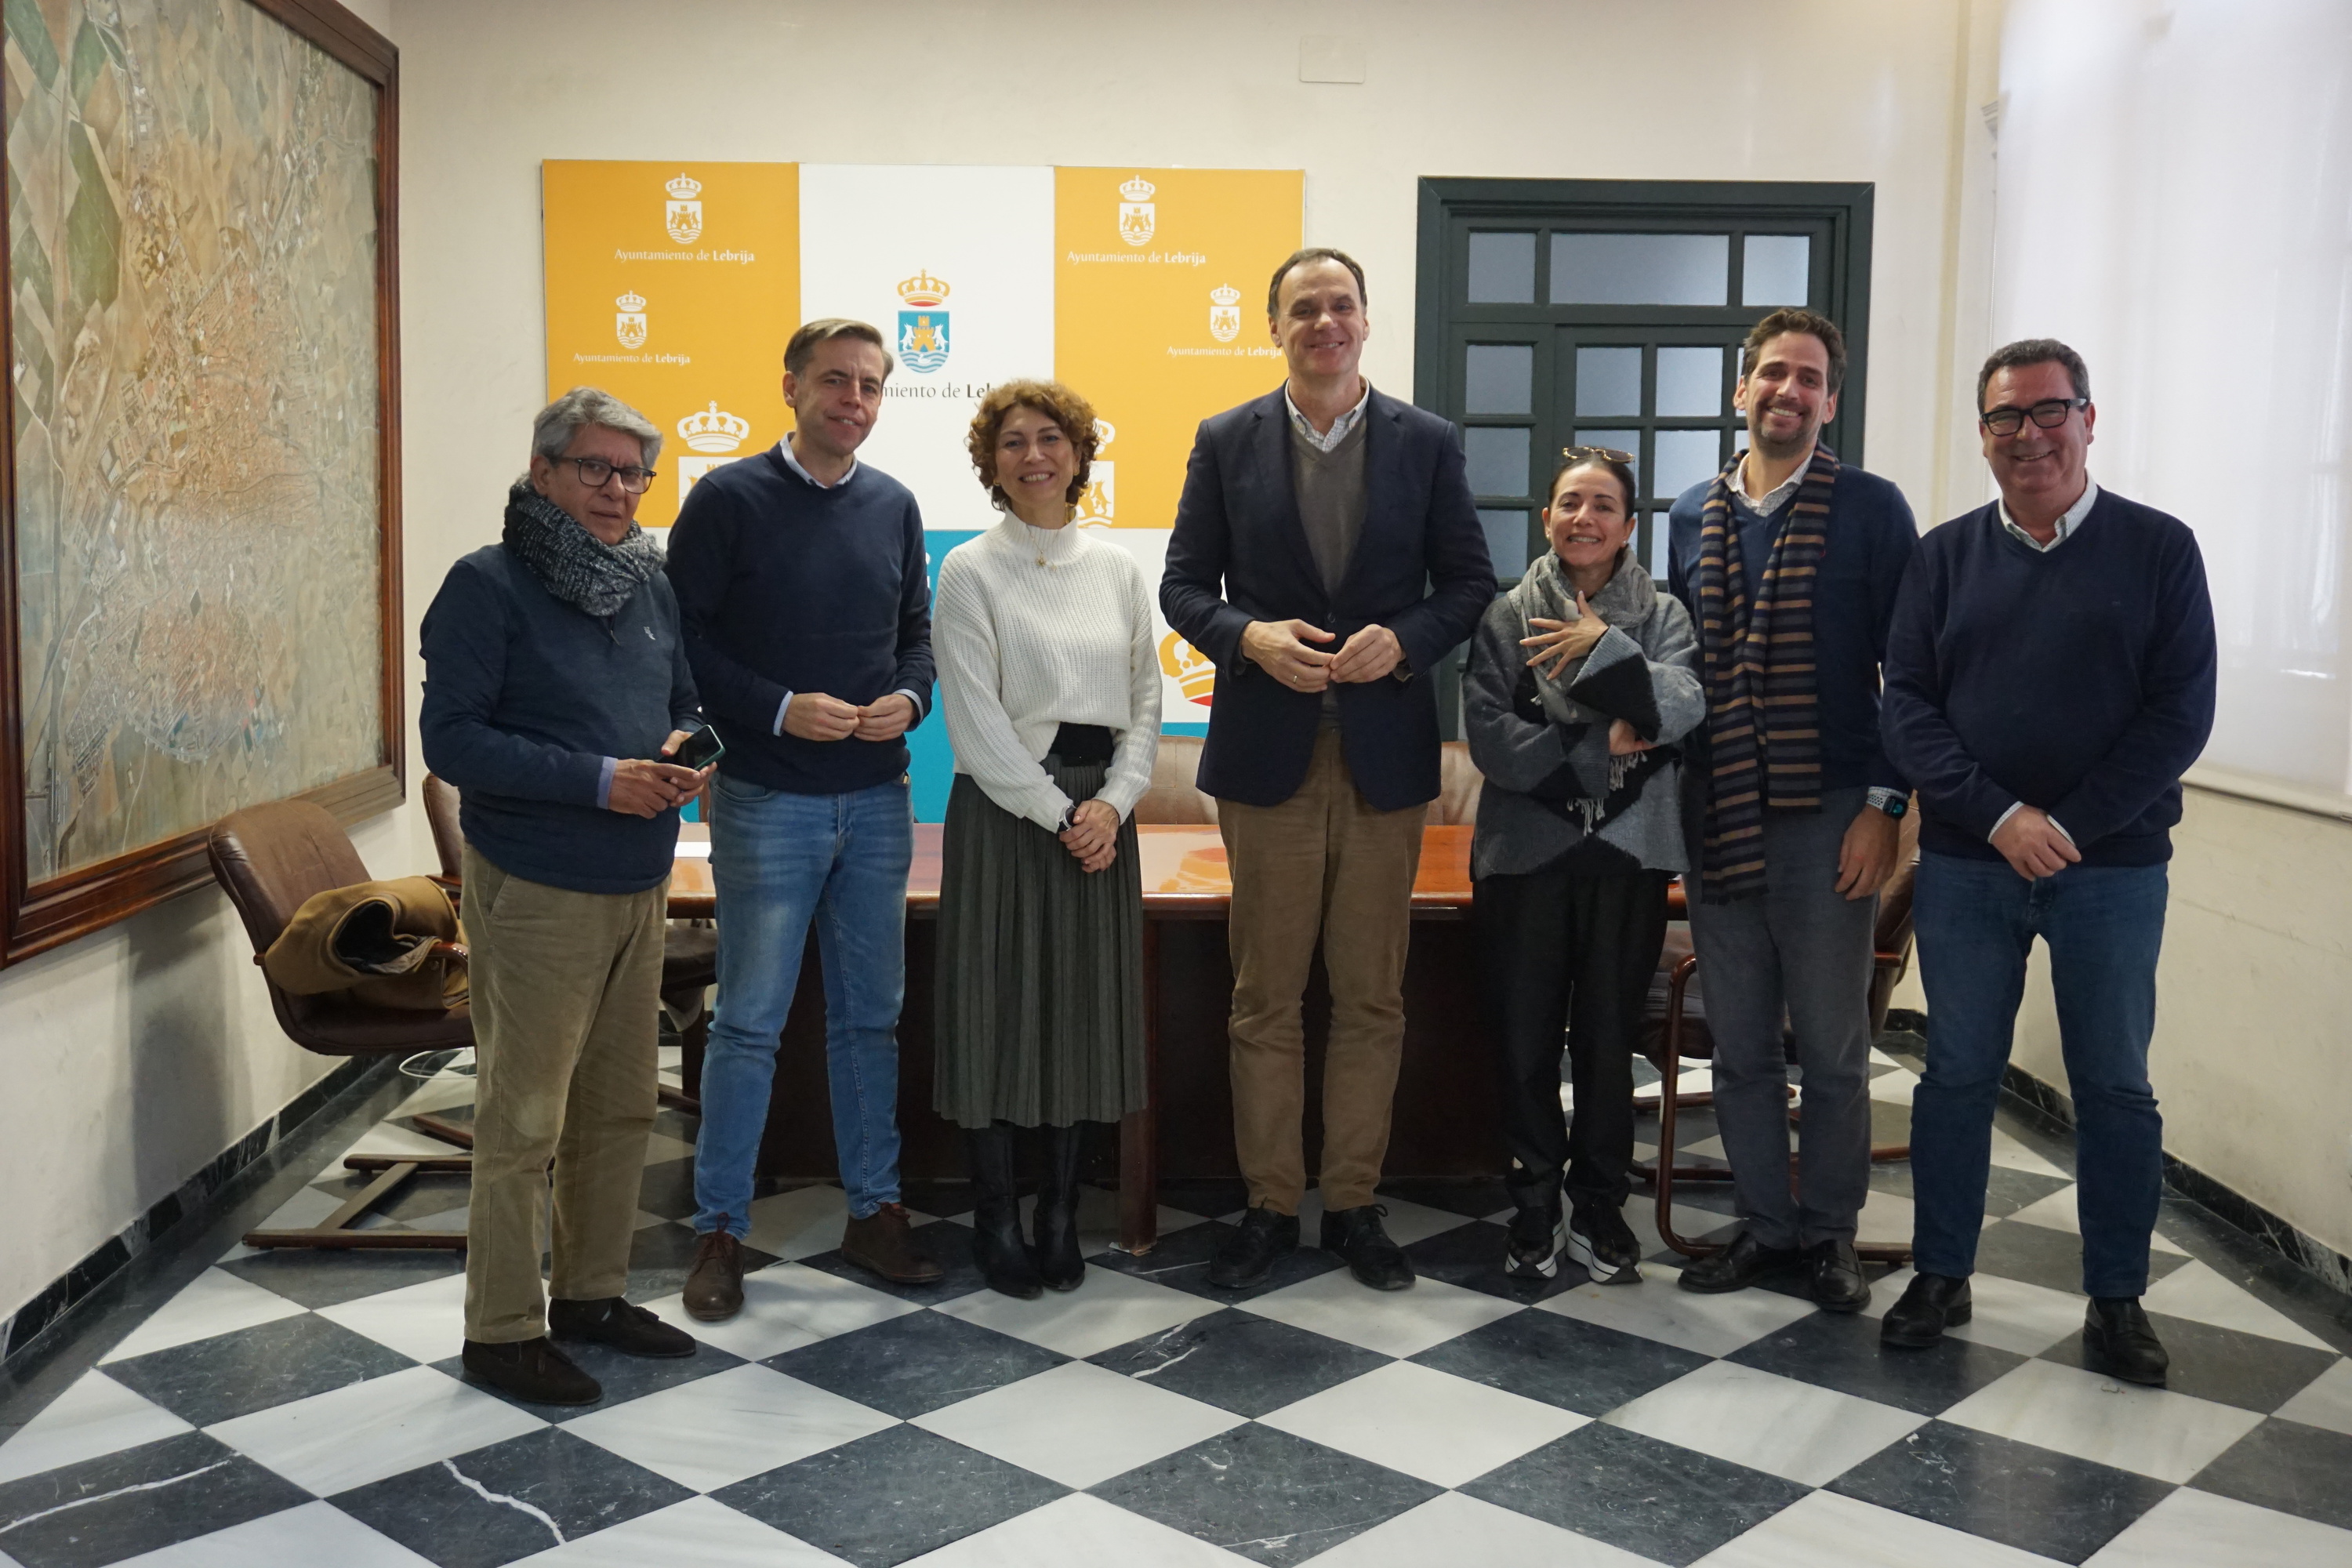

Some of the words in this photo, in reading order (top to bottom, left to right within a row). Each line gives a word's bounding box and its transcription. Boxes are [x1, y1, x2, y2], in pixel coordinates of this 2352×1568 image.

[615, 249, 693, 263] Ayuntamiento
[696, 249, 710, 261] de
[713, 250, 754, 264] Lebrija
[1066, 251, 1145, 265] Ayuntamiento
[1148, 251, 1161, 263] de
[1164, 252, 1206, 267] Lebrija
[573, 353, 639, 365] Ayuntamiento
[641, 353, 653, 363] de
[655, 354, 691, 365] Lebrija
[1167, 346, 1232, 358] Ayuntamiento
[1234, 346, 1245, 356] de
[1247, 347, 1282, 359] Lebrija
[883, 383, 936, 397] miento
[942, 382, 960, 398] de
